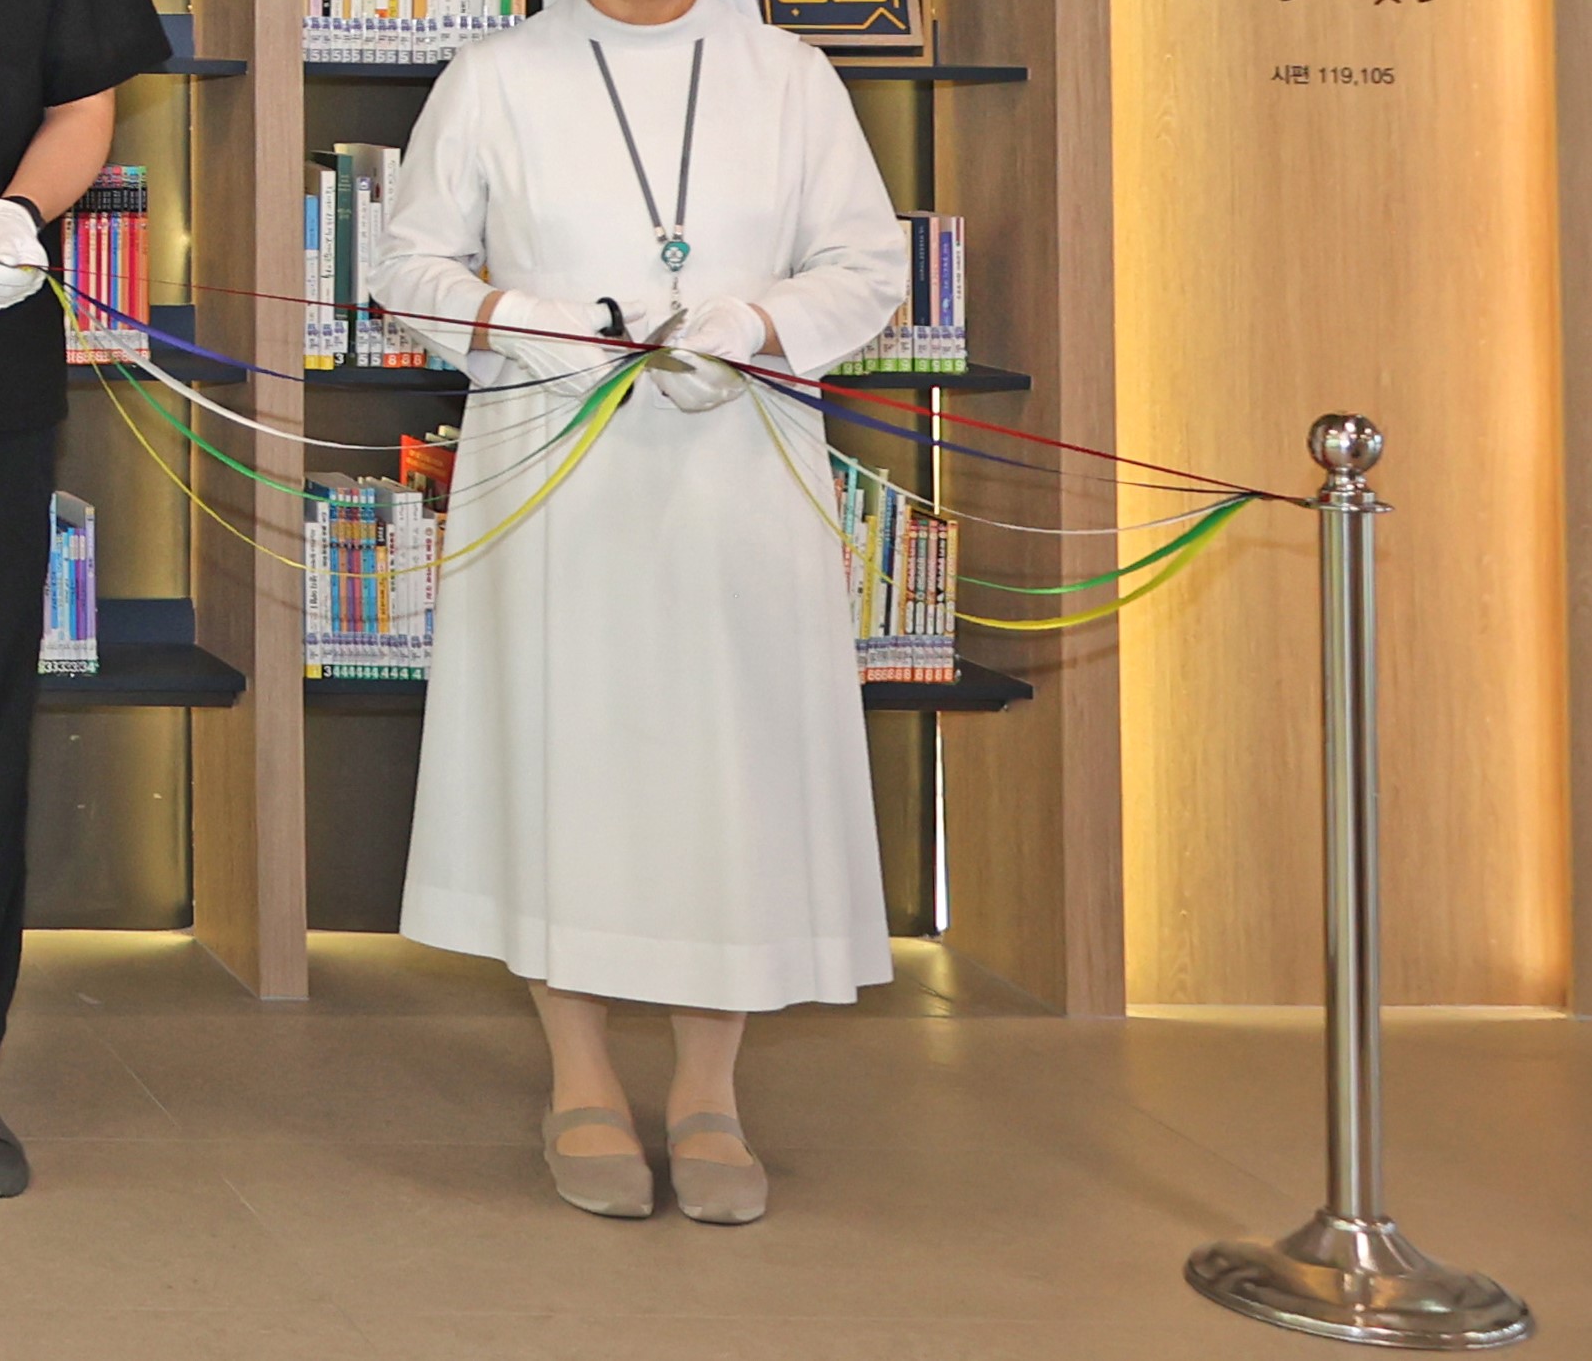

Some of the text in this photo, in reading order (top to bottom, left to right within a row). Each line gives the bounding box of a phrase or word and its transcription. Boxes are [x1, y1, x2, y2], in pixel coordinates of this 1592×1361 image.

[444, 48, 452, 59] 5
[1271, 65, 1311, 86] 시편
[334, 352, 344, 365] 3
[359, 354, 368, 366] 5
